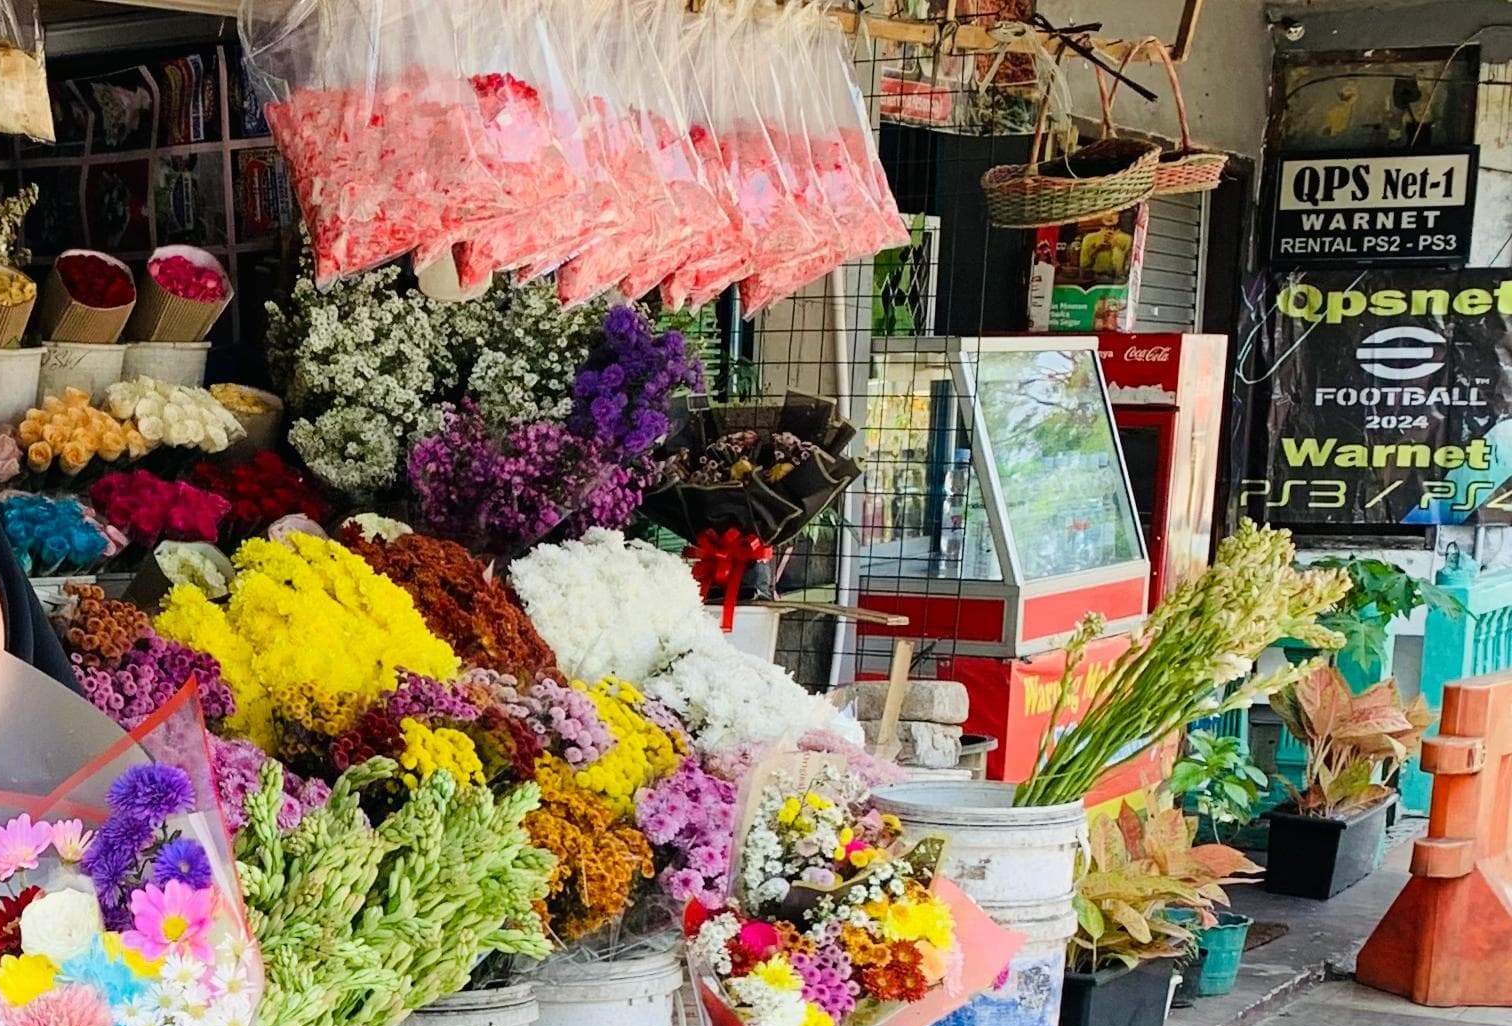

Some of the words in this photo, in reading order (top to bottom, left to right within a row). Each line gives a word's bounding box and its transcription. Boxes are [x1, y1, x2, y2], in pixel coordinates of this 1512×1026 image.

[1292, 164, 1370, 206] QPS
[1381, 166, 1455, 200] Net-1
[1301, 210, 1441, 231] WARNET
[1280, 237, 1357, 254] RENTAL
[1363, 236, 1401, 252] PS2
[1418, 234, 1457, 251] PS3
[1276, 280, 1512, 324] Qpsnet
[1315, 387, 1487, 406] FOOTBALL
[1365, 415, 1429, 430] 2024
[1281, 438, 1492, 469] Warnet
[1241, 479, 1347, 508] PS3
